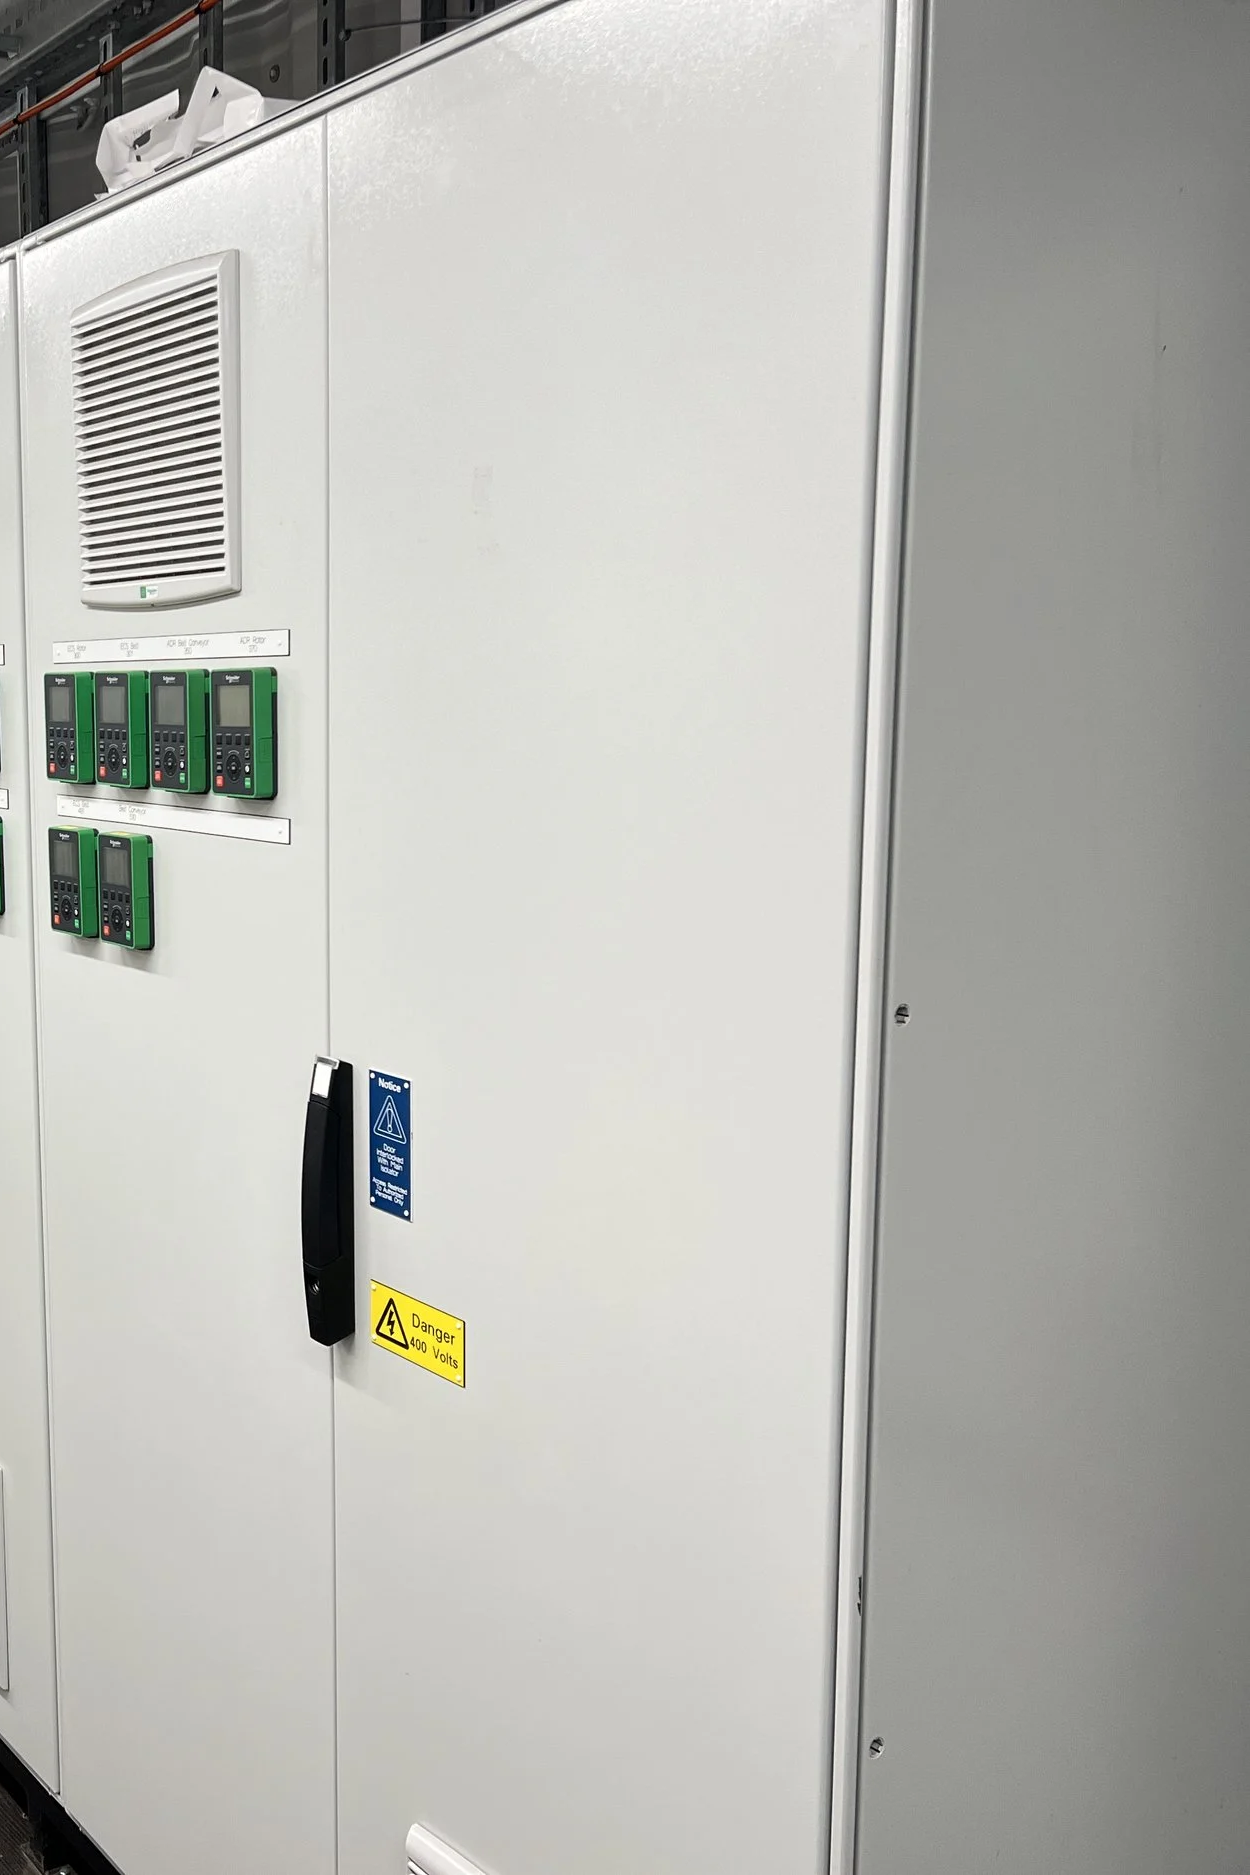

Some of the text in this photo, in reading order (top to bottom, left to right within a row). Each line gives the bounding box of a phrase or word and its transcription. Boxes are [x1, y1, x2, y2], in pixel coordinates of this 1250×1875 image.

[378, 1076, 402, 1094] Notice
[383, 1142, 397, 1154] Door
[376, 1155, 403, 1172] With Main
[393, 1196, 404, 1207] Only
[412, 1312, 456, 1346] Danger
[410, 1336, 459, 1370] 400 Volts
